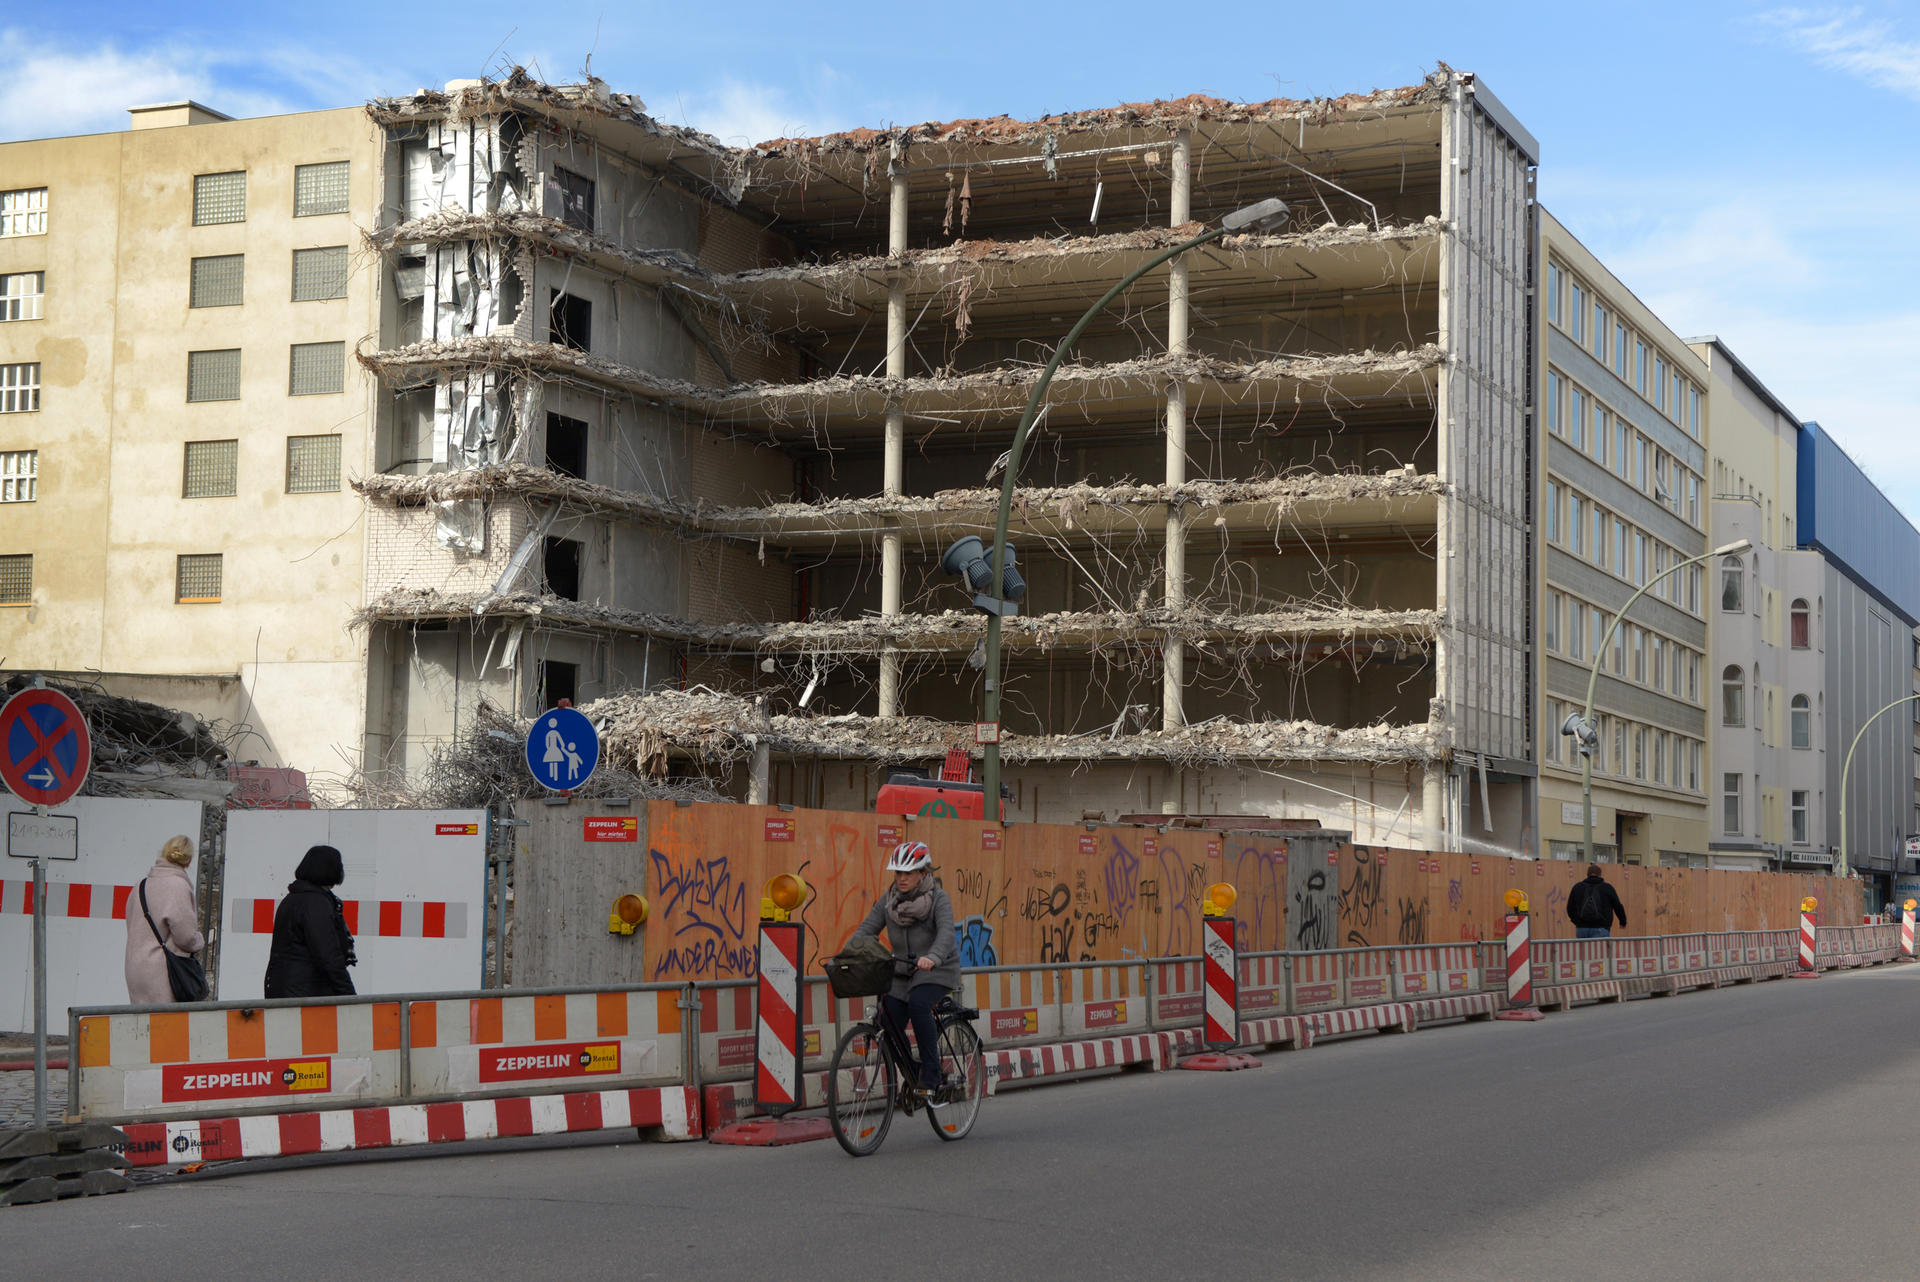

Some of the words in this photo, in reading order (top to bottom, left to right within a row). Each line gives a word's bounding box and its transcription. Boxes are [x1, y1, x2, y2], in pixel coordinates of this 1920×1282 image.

[1090, 1008, 1113, 1020] ZEPPELIN
[996, 1017, 1021, 1030] ZEPPELIN
[496, 1054, 571, 1071] ZEPPELIN
[592, 1055, 616, 1063] Rental
[183, 1071, 273, 1090] ZEPPELIN
[283, 1072, 295, 1082] CAT
[297, 1071, 325, 1080] Rental
